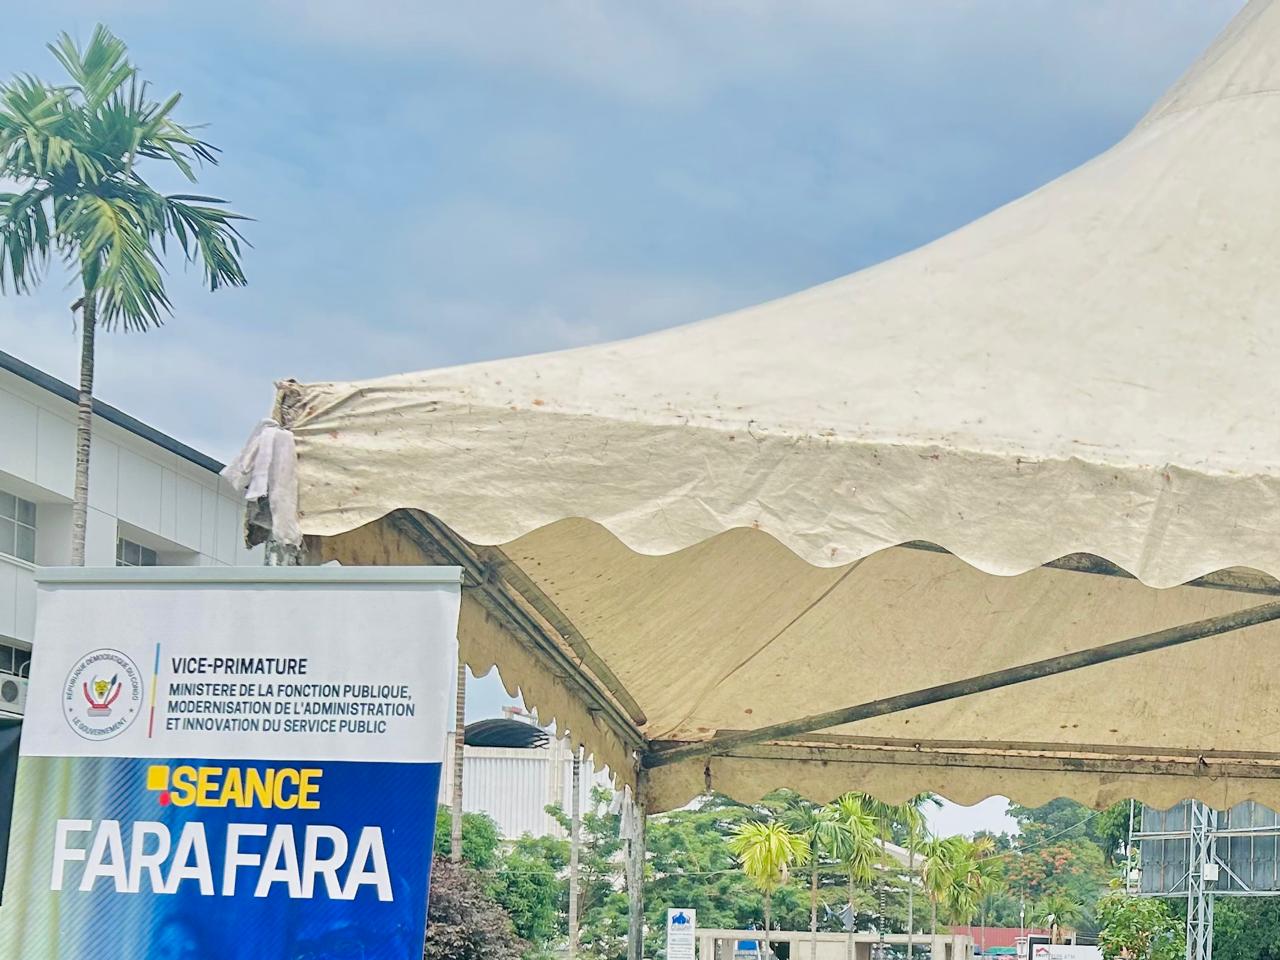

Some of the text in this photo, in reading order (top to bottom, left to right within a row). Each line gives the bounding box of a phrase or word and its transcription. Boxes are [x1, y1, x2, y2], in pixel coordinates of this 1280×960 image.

[171, 657, 308, 675] VICE-PRIMATURE
[168, 683, 412, 701] MINISTERE DE LA FONCTION PUBLIQUE,
[167, 700, 415, 717] MODERNISATION DE L'ADMINISTRATION
[166, 717, 387, 734] ET INNOVATION DU SERVICE PUBLIC
[170, 765, 323, 810] SEANCE
[50, 819, 394, 902] FARA FARA
